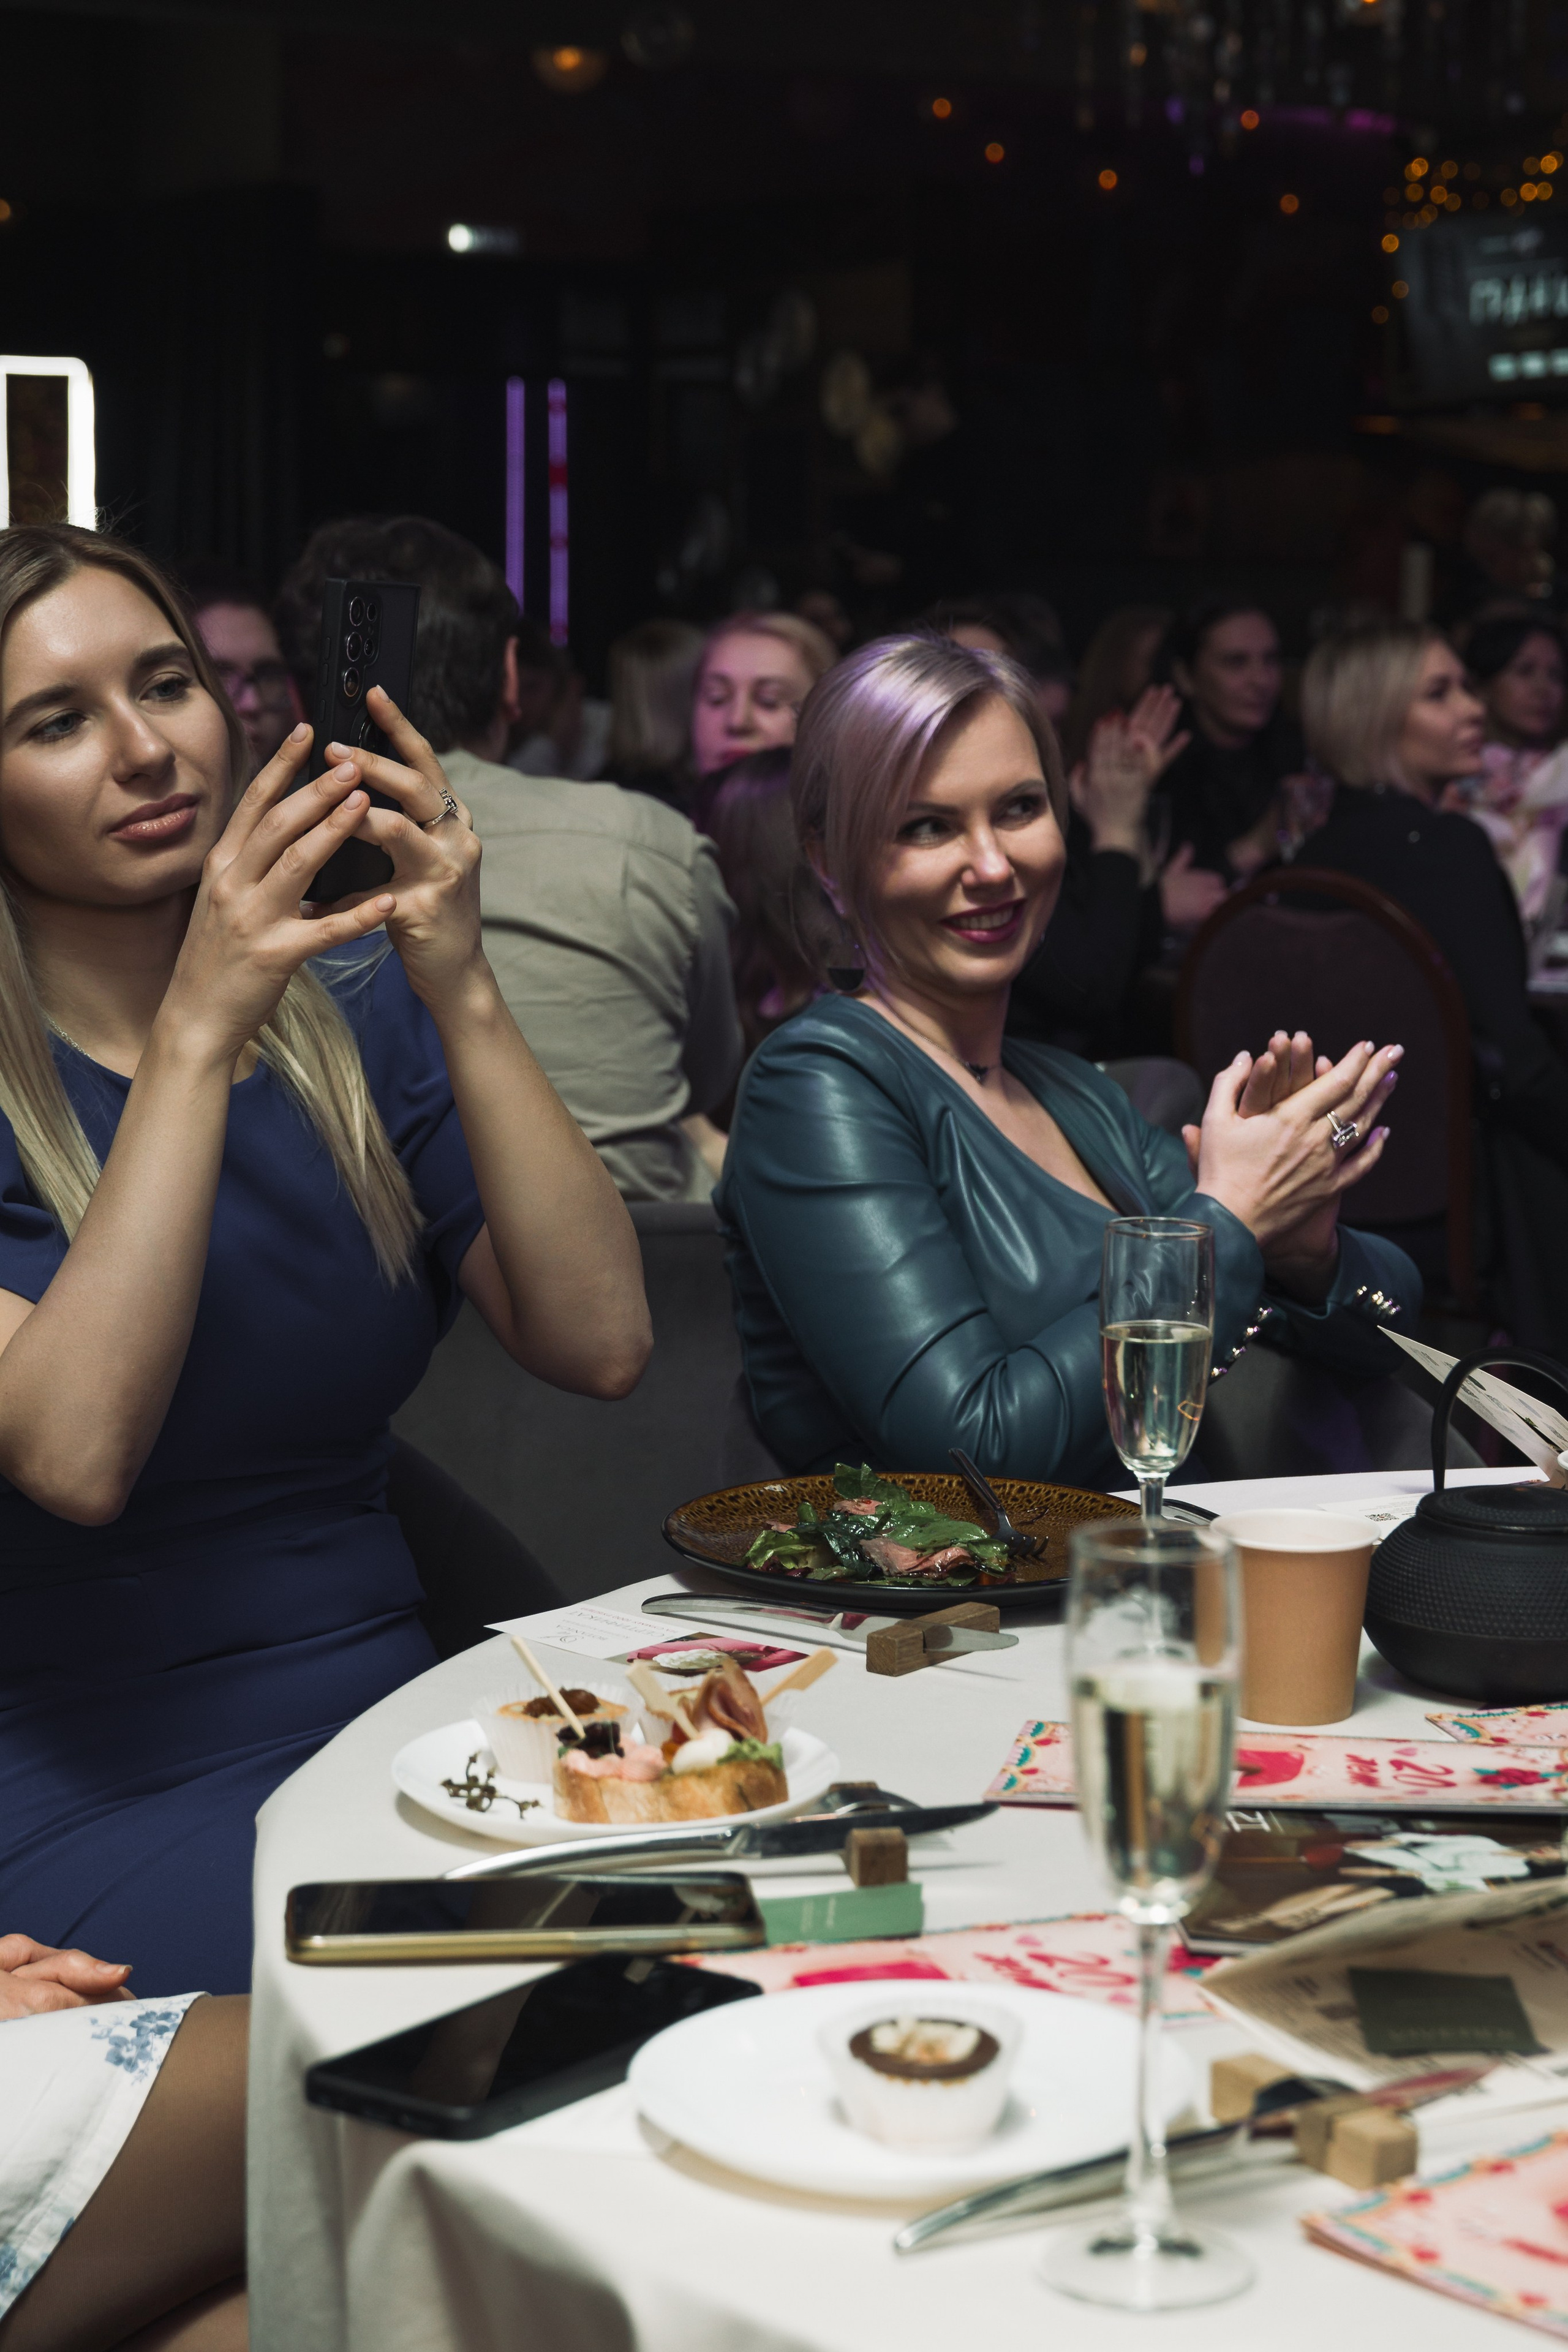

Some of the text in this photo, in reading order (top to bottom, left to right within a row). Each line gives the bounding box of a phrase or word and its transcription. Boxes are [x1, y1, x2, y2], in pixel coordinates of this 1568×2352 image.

[566, 1611, 664, 1637] СЕРТИФИКАТ
[1389, 1758, 1457, 1788] 20
[1027, 1951, 1138, 1988] 20
